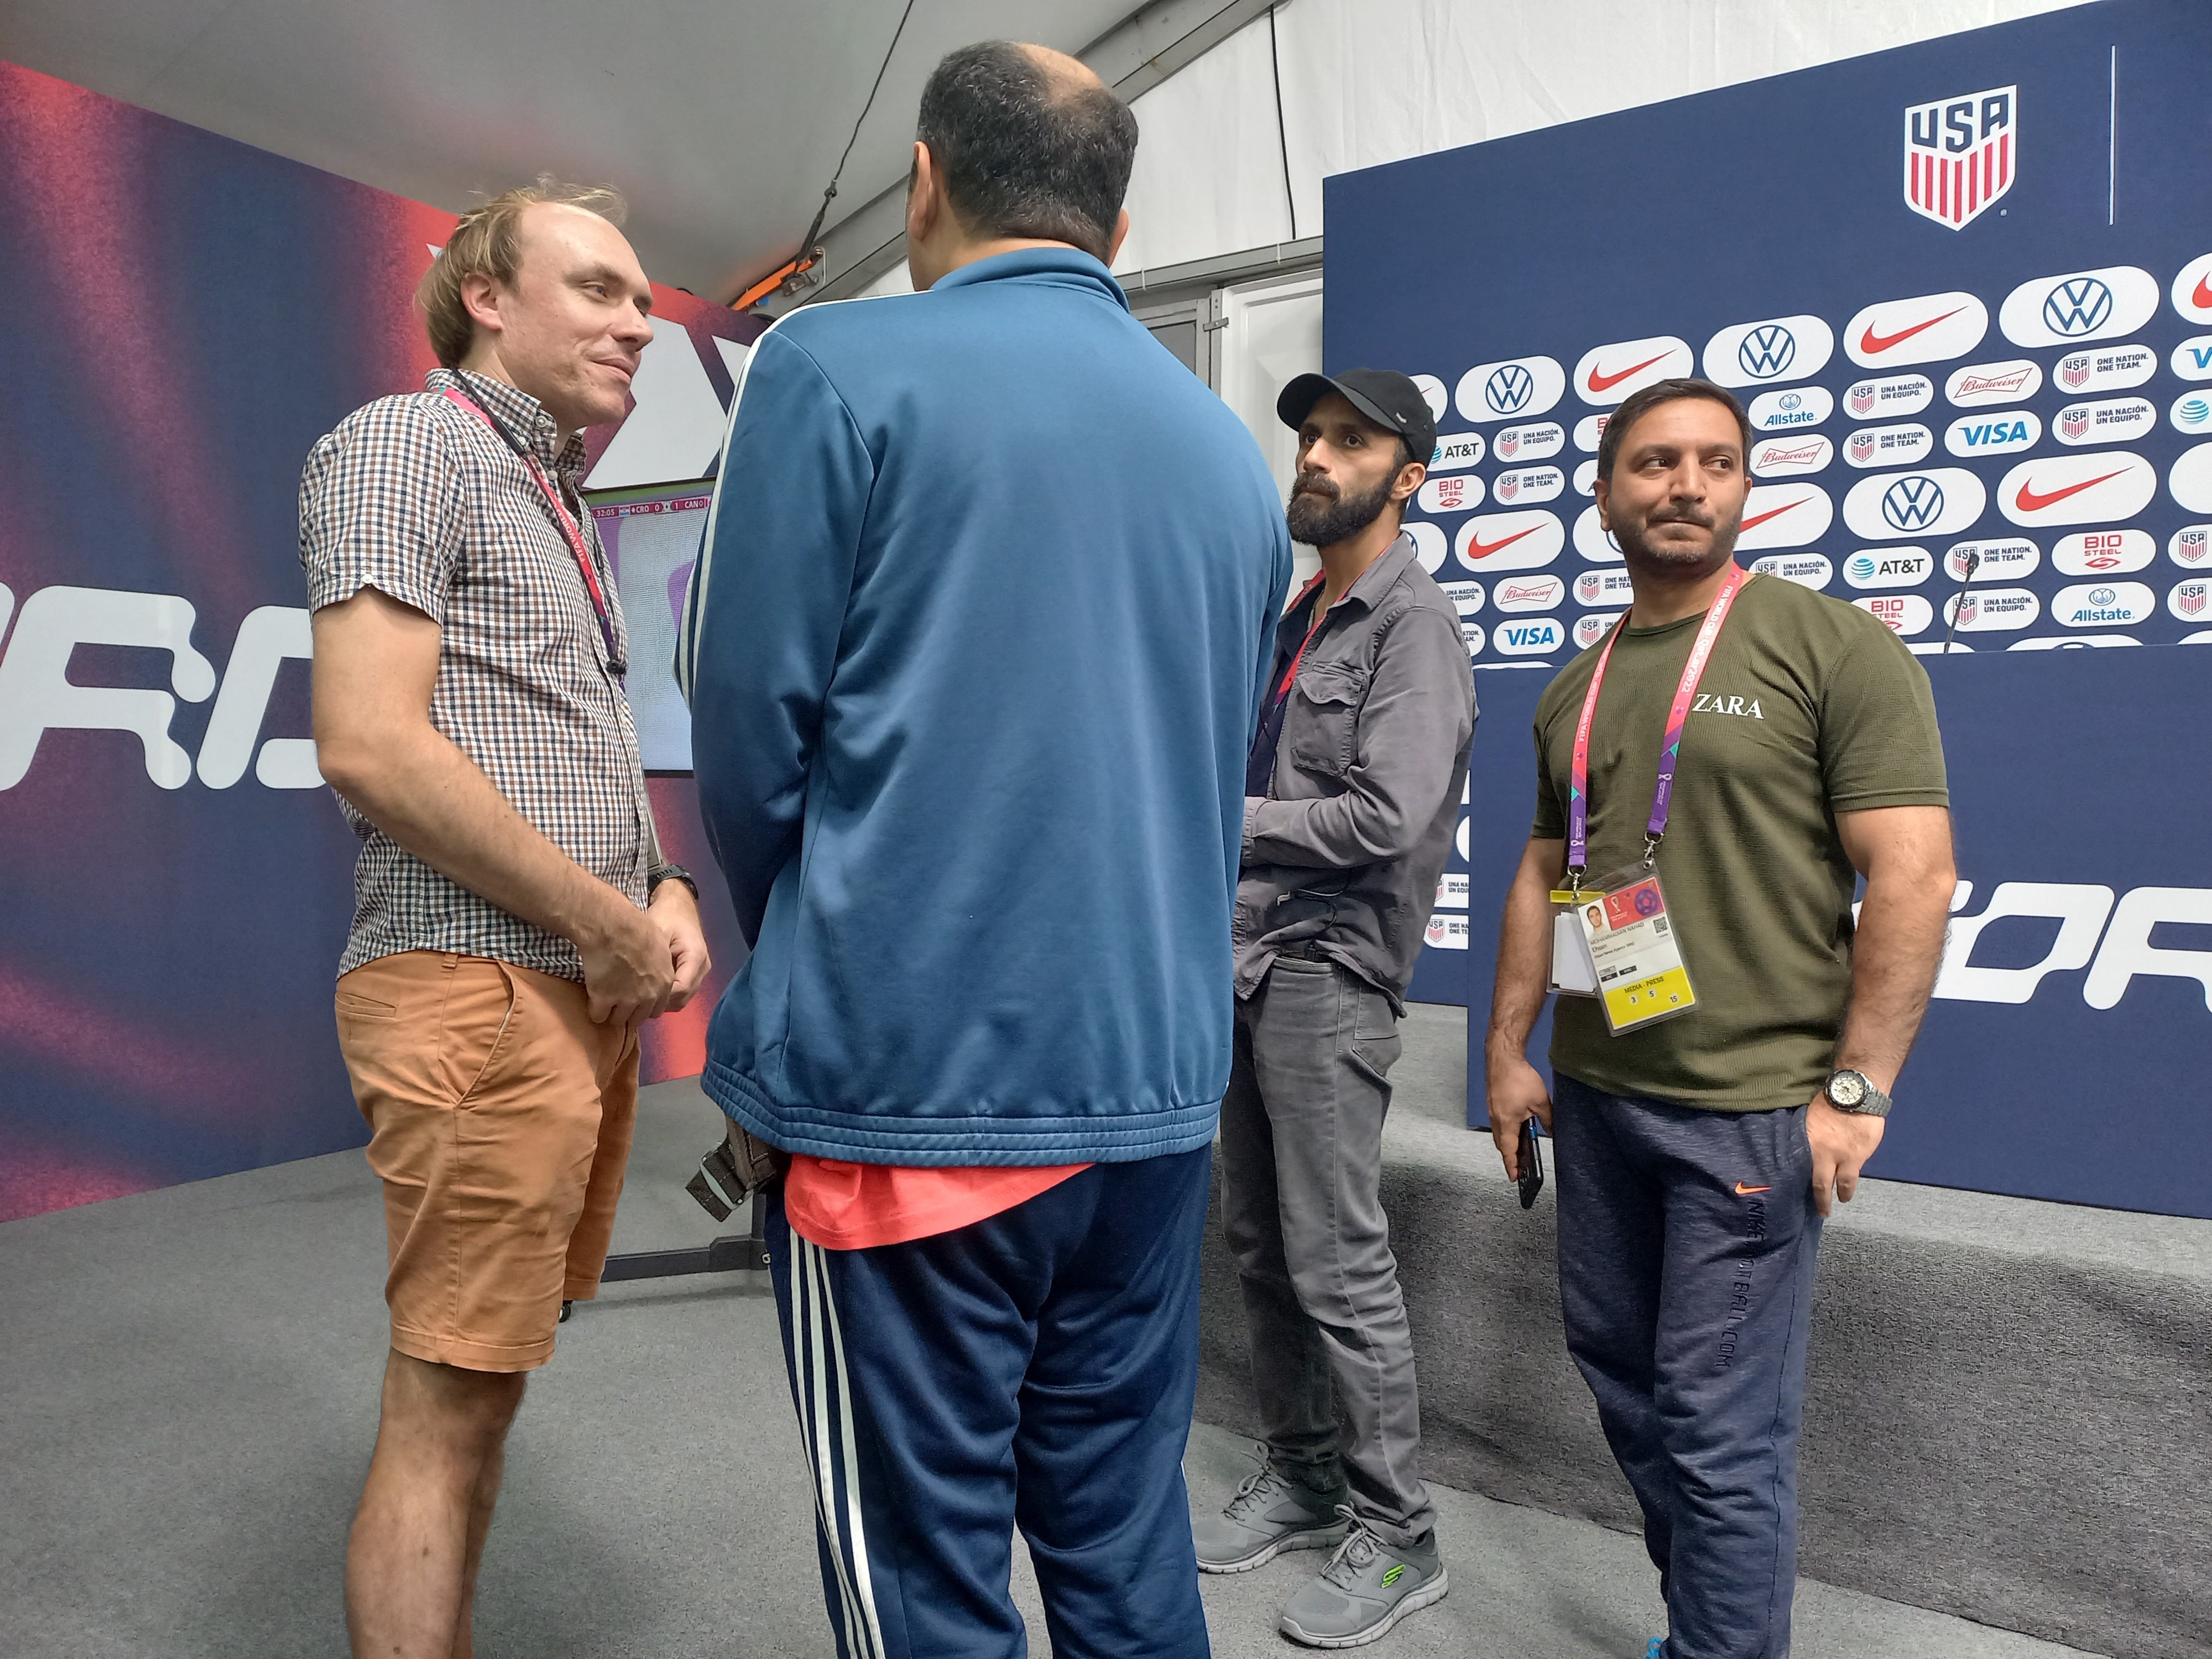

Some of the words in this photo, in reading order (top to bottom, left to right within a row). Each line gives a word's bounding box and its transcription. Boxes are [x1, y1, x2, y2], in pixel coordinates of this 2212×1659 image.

[1912, 93, 2008, 153] USA
[2065, 359, 2088, 371] USA
[2098, 357, 2114, 366] ONE
[2116, 353, 2149, 363] NATION.
[2115, 361, 2141, 370] TEAM.
[1897, 382, 1927, 392] NACIÓN.
[1961, 377, 2023, 392] Budweiser
[1853, 388, 1873, 398] USA
[1892, 390, 1921, 399] EQUIPO.
[2115, 405, 2149, 415] NACIÓN.
[1764, 411, 1814, 427] Allstate
[2065, 411, 2086, 422] USA
[2109, 414, 2142, 424] EQUIPO.
[1502, 434, 1517, 443] USA
[1534, 429, 1559, 437] NACIÓN.
[1897, 431, 1926, 440] NATION.
[1958, 421, 2027, 446] VISA
[1532, 436, 1555, 445] EQUIPO.
[1853, 437, 1873, 446] USA
[1897, 438, 1919, 447] TEAM.
[1444, 442, 1479, 459] AT&T
[1762, 451, 1817, 463] Budweiser
[1439, 479, 1463, 492] BIO
[1501, 477, 1517, 486] USA
[596, 508, 615, 517] 32:05
[685, 500, 698, 508] CAN
[556, 509, 576, 542] WORLD
[2084, 535, 2122, 549] BIO
[2182, 533, 2204, 544] USA
[2001, 546, 2032, 555] NATION.
[1757, 563, 1776, 573] USA
[1799, 560, 1827, 569] NACIÓN.
[1879, 559, 1925, 575] AT&T
[1582, 577, 1598, 587] USA
[1505, 586, 1551, 599] Budweiser
[2181, 587, 2204, 598] USA
[1871, 599, 1903, 612] BIO
[1984, 598, 2000, 607] UNA
[2001, 595, 2032, 605] NACIÓN.
[1710, 594, 1728, 622] WORLD
[1996, 604, 2026, 612] EQUIPO.
[2070, 607, 2131, 622] Allstate
[1582, 621, 1598, 630] USA
[1503, 627, 1554, 646] VISA
[1692, 693, 1764, 719] ZARA
[1578, 724, 1587, 742] FIFA
[1583, 696, 1594, 727] WORLD
[1429, 921, 1443, 929] USA
[1624, 983, 1642, 994] MEDIA
[1646, 976, 1664, 987] PRESS
